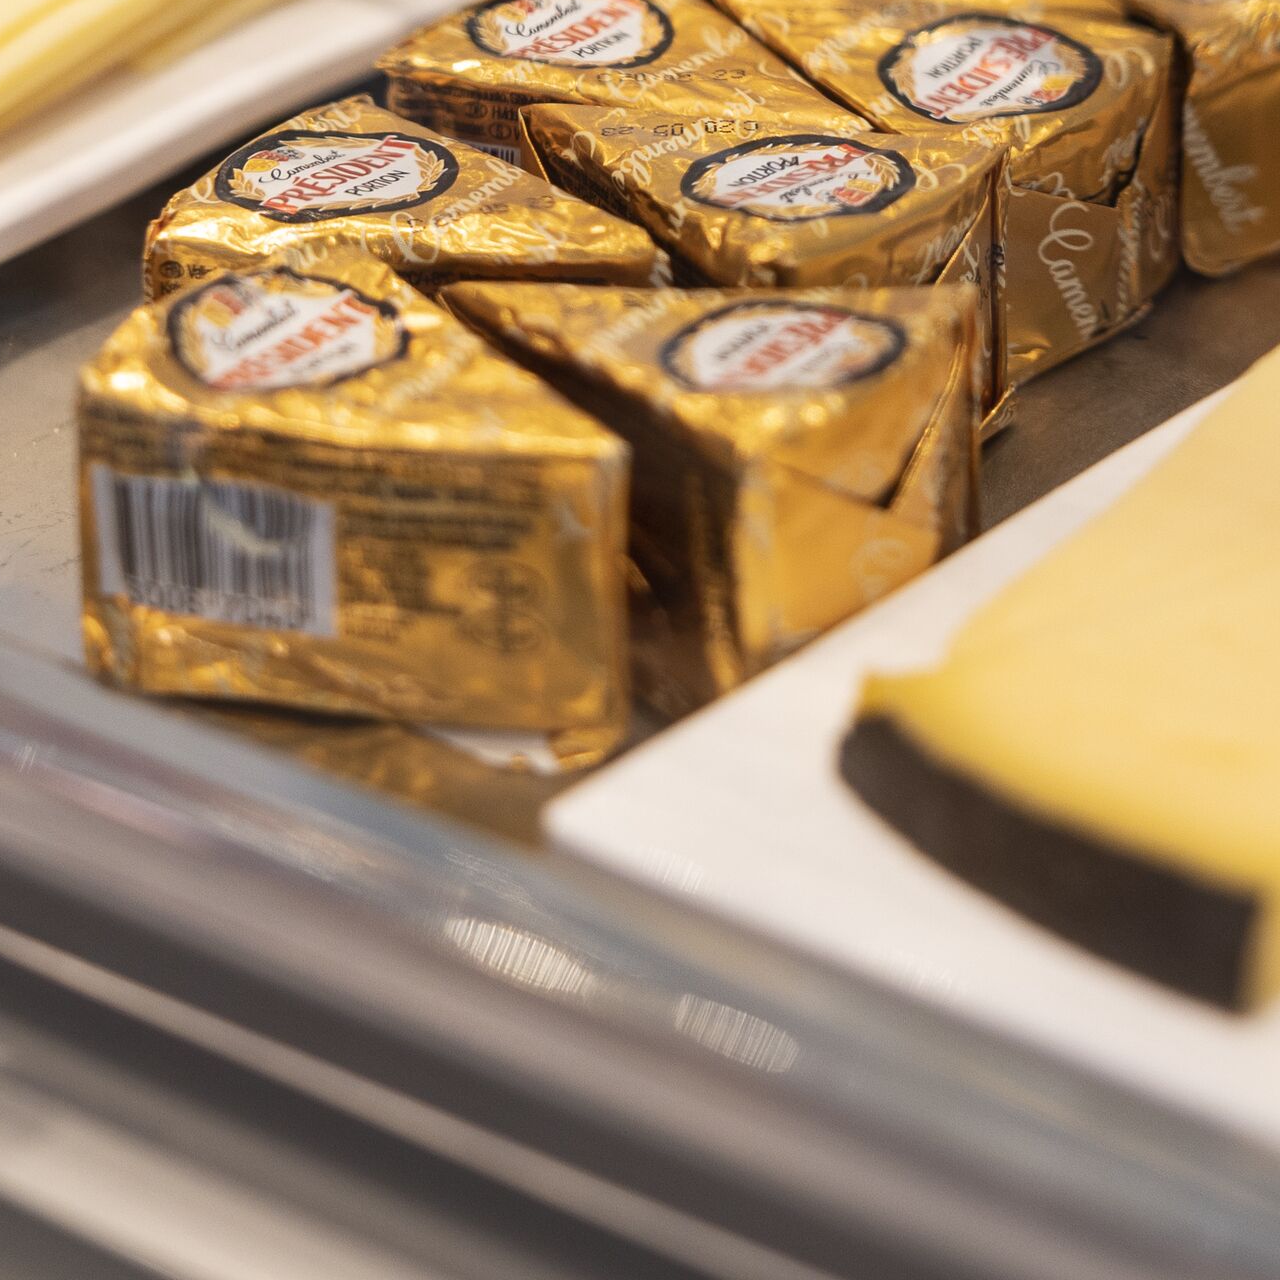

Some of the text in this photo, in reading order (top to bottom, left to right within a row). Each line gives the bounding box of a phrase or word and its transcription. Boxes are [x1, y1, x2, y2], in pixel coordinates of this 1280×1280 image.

[572, 30, 631, 58] PORTION
[258, 148, 346, 184] Camembert
[261, 135, 417, 215] PRÉSIDENT
[344, 169, 411, 197] PORTION
[728, 154, 800, 188] PORTION
